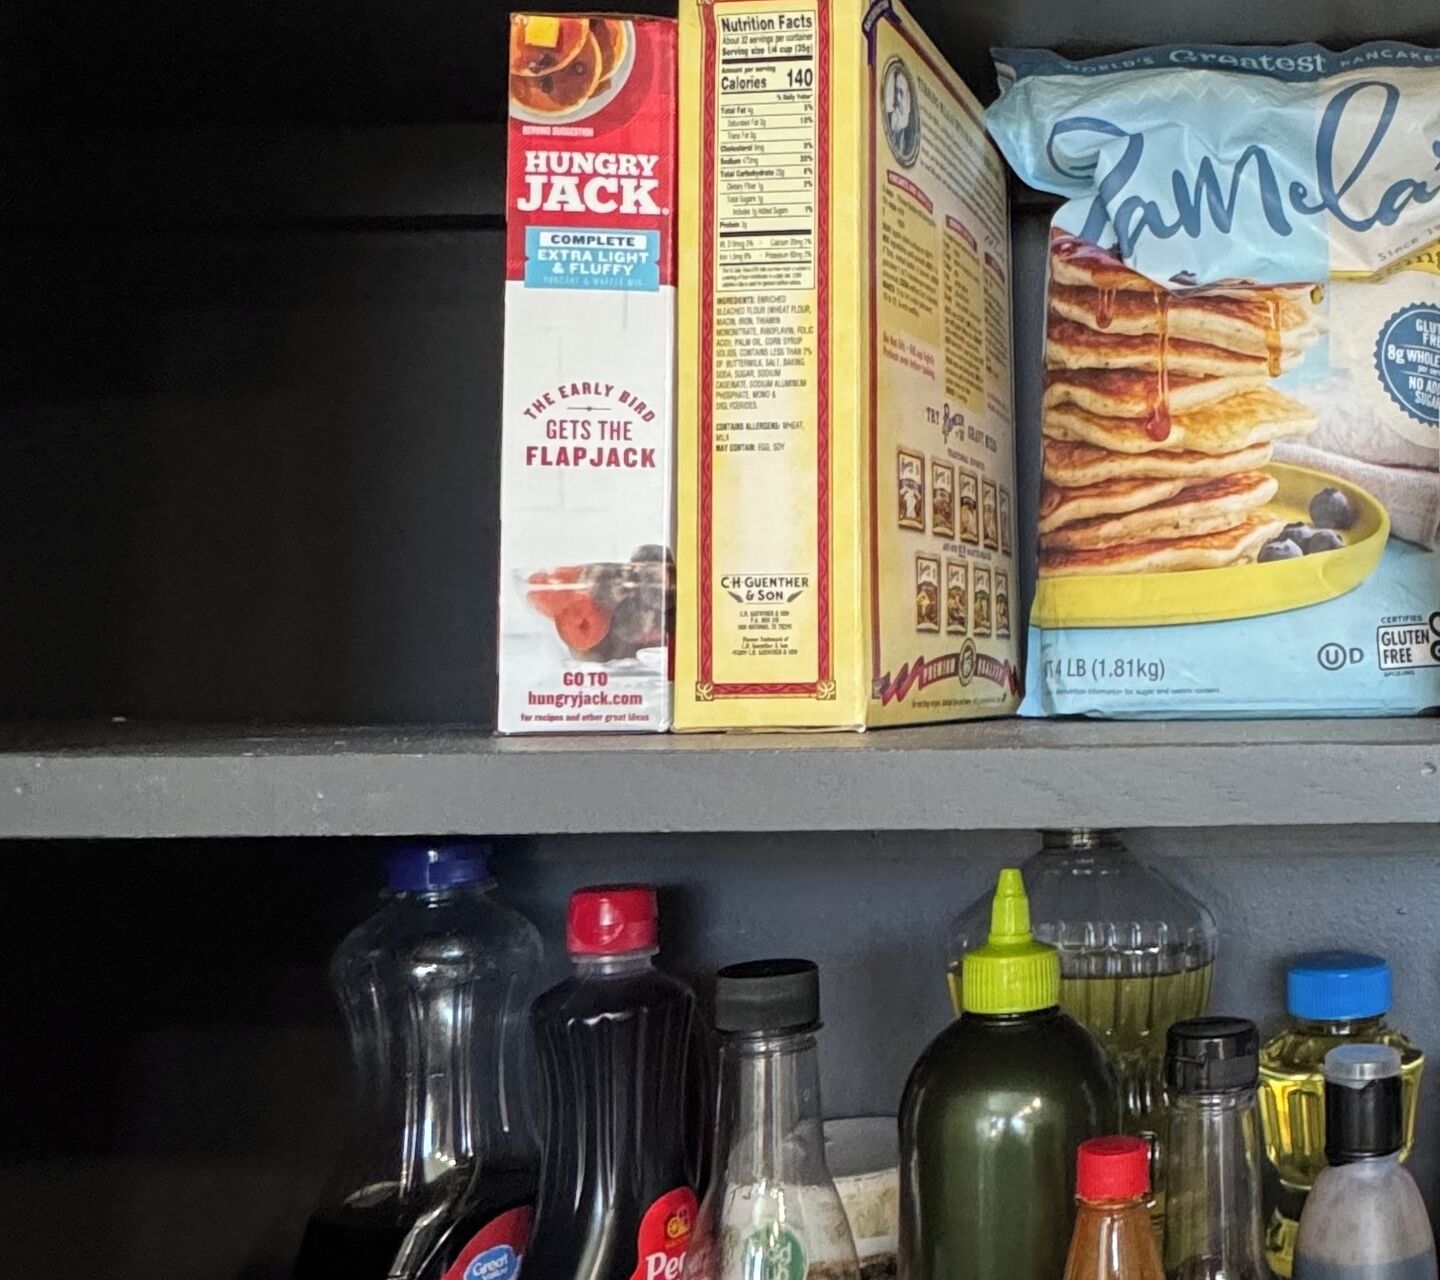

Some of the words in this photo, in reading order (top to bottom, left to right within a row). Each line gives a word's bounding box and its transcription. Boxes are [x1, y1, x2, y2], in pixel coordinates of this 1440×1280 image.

[722, 16, 774, 32] Nutrition
[779, 15, 812, 30] Facts
[1169, 49, 1327, 74] Greatest
[722, 76, 766, 90] Calories
[787, 69, 812, 87] 140
[525, 151, 659, 176] HUNGRY
[551, 235, 635, 246] COMPLETE
[537, 250, 592, 261] EXTRA
[600, 251, 649, 264] LIGHT
[552, 264, 564, 274] &
[570, 264, 634, 276] FLUFFY
[1387, 345, 1405, 364] 8g
[1407, 350, 1440, 369] WHOLE
[524, 392, 555, 419] THE
[558, 382, 614, 399] EARLY
[618, 390, 655, 422] BIRD
[546, 420, 591, 440] GETS
[599, 421, 632, 441] THE
[526, 446, 656, 468] FLAPJACK
[1381, 628, 1430, 646] GLUTEN
[1383, 648, 1413, 664] FREE
[563, 672, 584, 686] GO
[588, 672, 608, 686] TO
[528, 691, 642, 708] hungryjack.com
